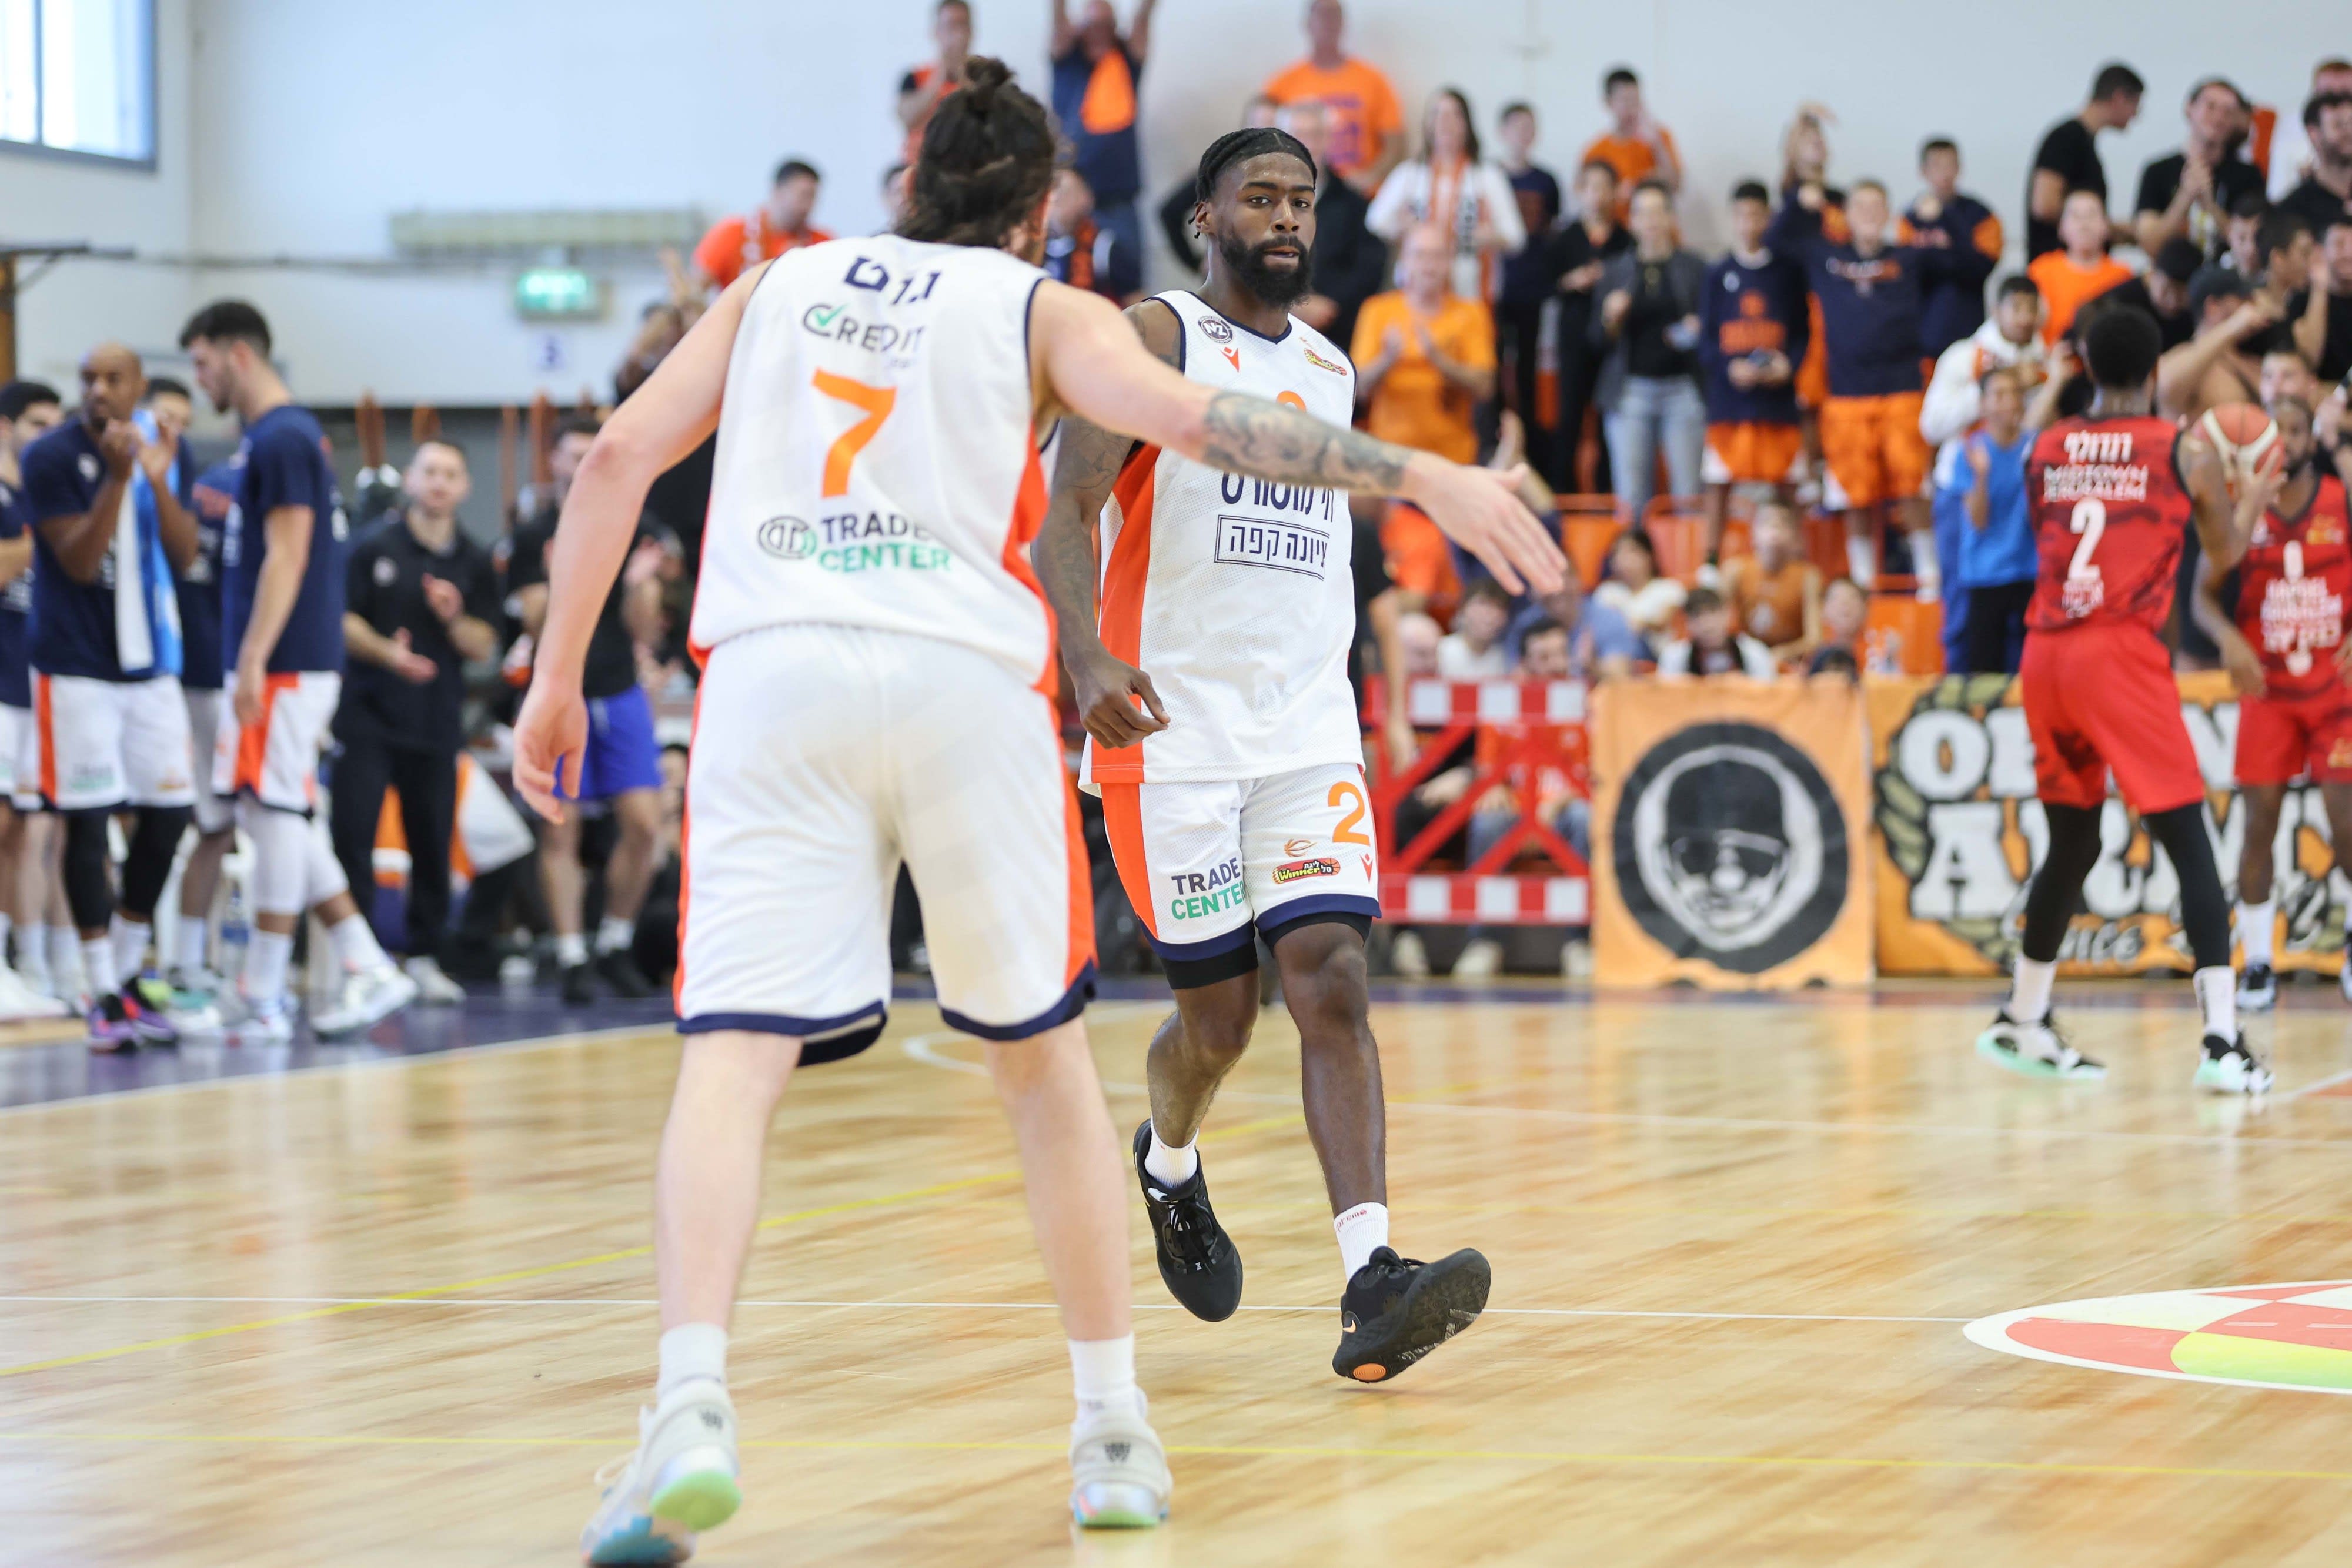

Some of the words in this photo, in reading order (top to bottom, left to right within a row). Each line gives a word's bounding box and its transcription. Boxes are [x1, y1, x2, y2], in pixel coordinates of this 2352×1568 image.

[811, 367, 897, 499] 7
[819, 541, 951, 573] CENTER
[1230, 526, 1279, 561] קפה
[2068, 497, 2106, 580] 2
[1328, 781, 1370, 847] 2
[1171, 857, 1241, 895] TRADE
[1278, 867, 1320, 881] Winner
[1171, 880, 1246, 920] CENTER
